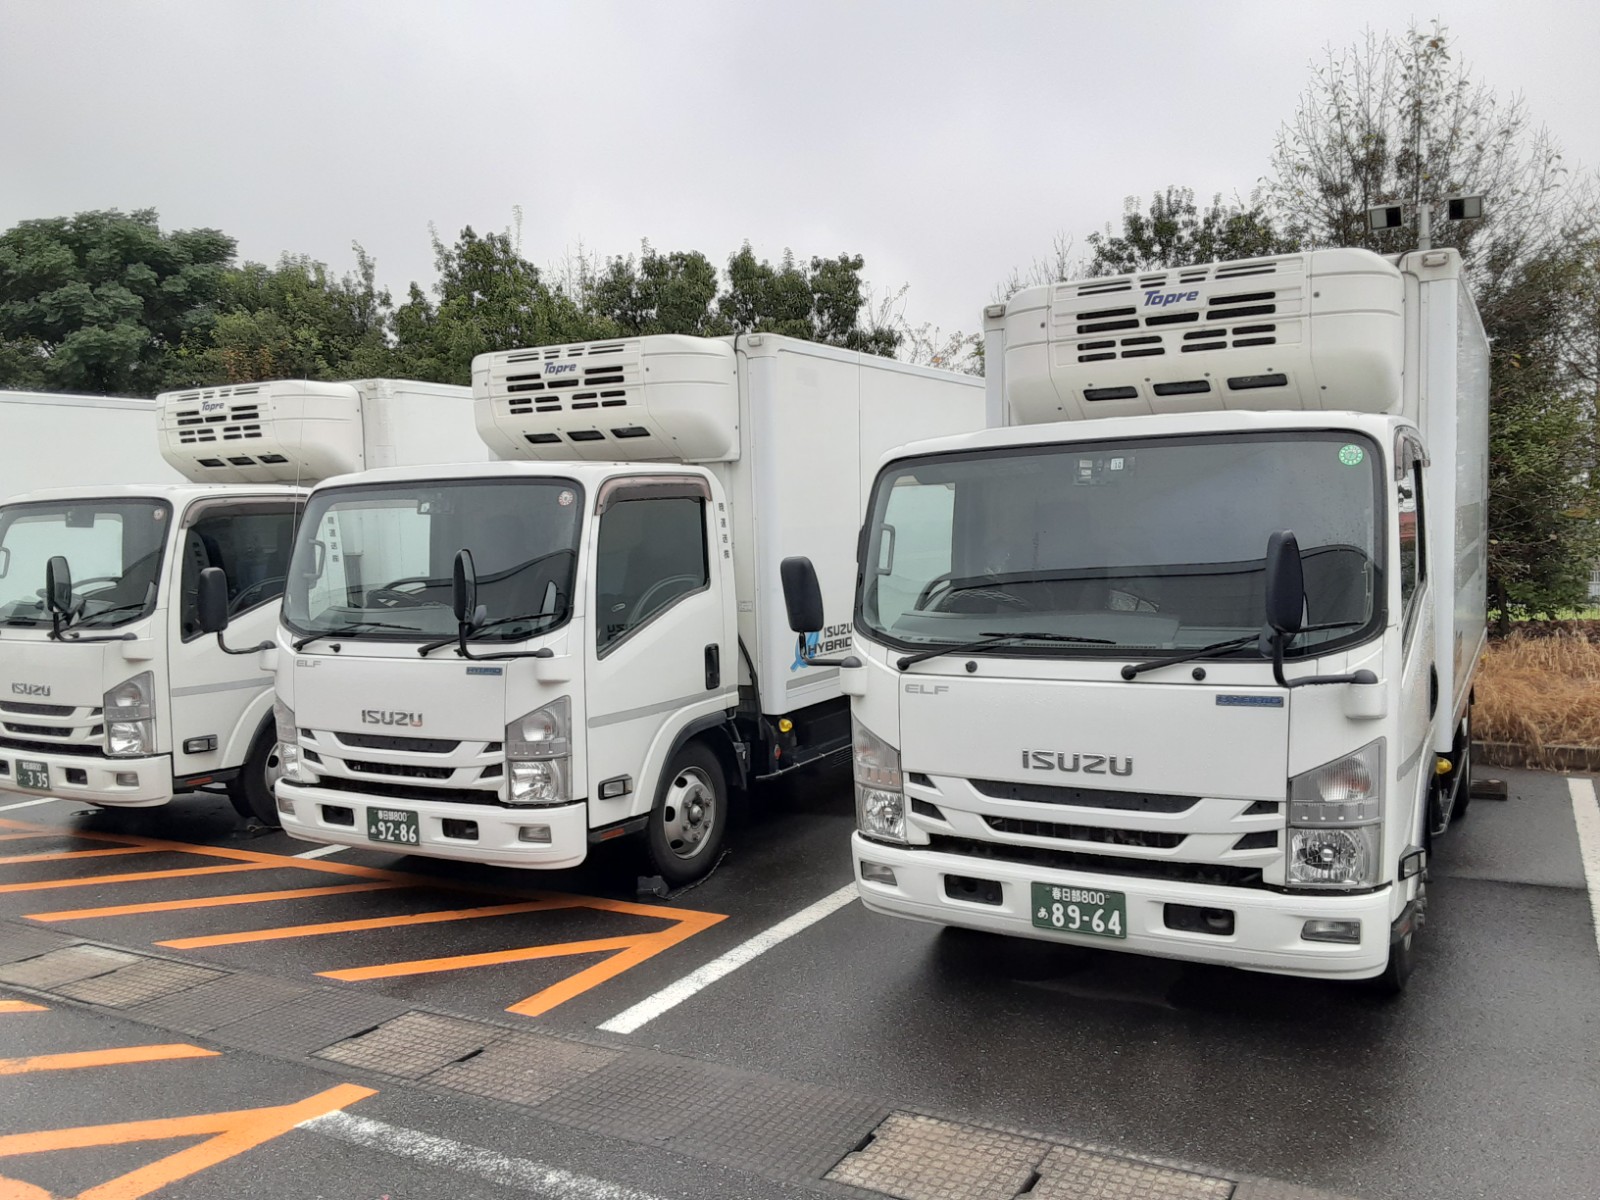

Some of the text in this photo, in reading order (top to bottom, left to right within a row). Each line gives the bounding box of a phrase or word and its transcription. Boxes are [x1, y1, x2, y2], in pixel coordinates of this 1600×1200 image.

[1144, 290, 1199, 307] Topre
[544, 362, 577, 375] Topre
[202, 401, 225, 412] Topre
[823, 622, 853, 638] ISUZU
[296, 660, 321, 668] ELF
[11, 682, 51, 697] ISUZU
[905, 684, 949, 695] ELF
[361, 709, 423, 727] ISUZU
[1021, 749, 1133, 776] ISUZU
[377, 821, 417, 843] 92-86
[1052, 887, 1105, 905] 春日部800
[1037, 903, 1121, 935] あ 89-64
